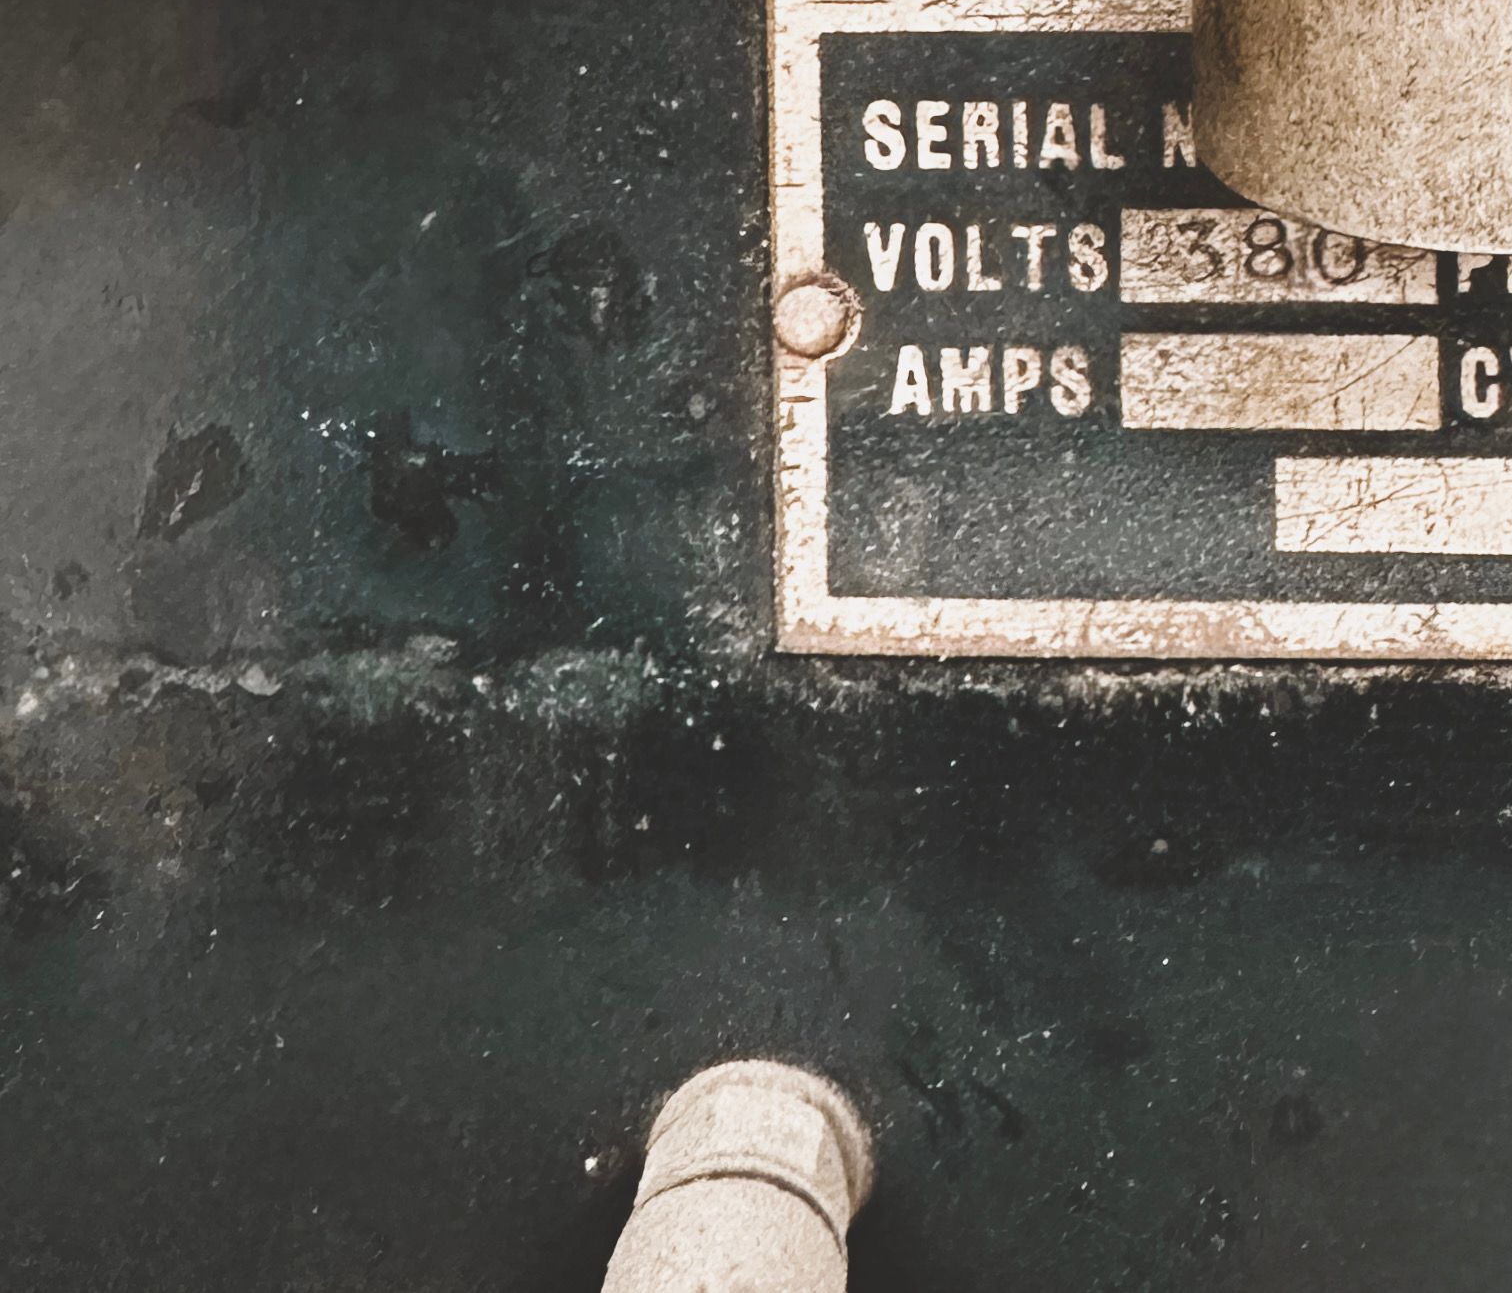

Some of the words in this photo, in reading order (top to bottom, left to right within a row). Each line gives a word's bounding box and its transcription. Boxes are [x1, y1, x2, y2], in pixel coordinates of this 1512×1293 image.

[861, 99, 1127, 172] SERIAL
[862, 222, 1110, 293] VOLTS
[887, 345, 1093, 418] AMPS
